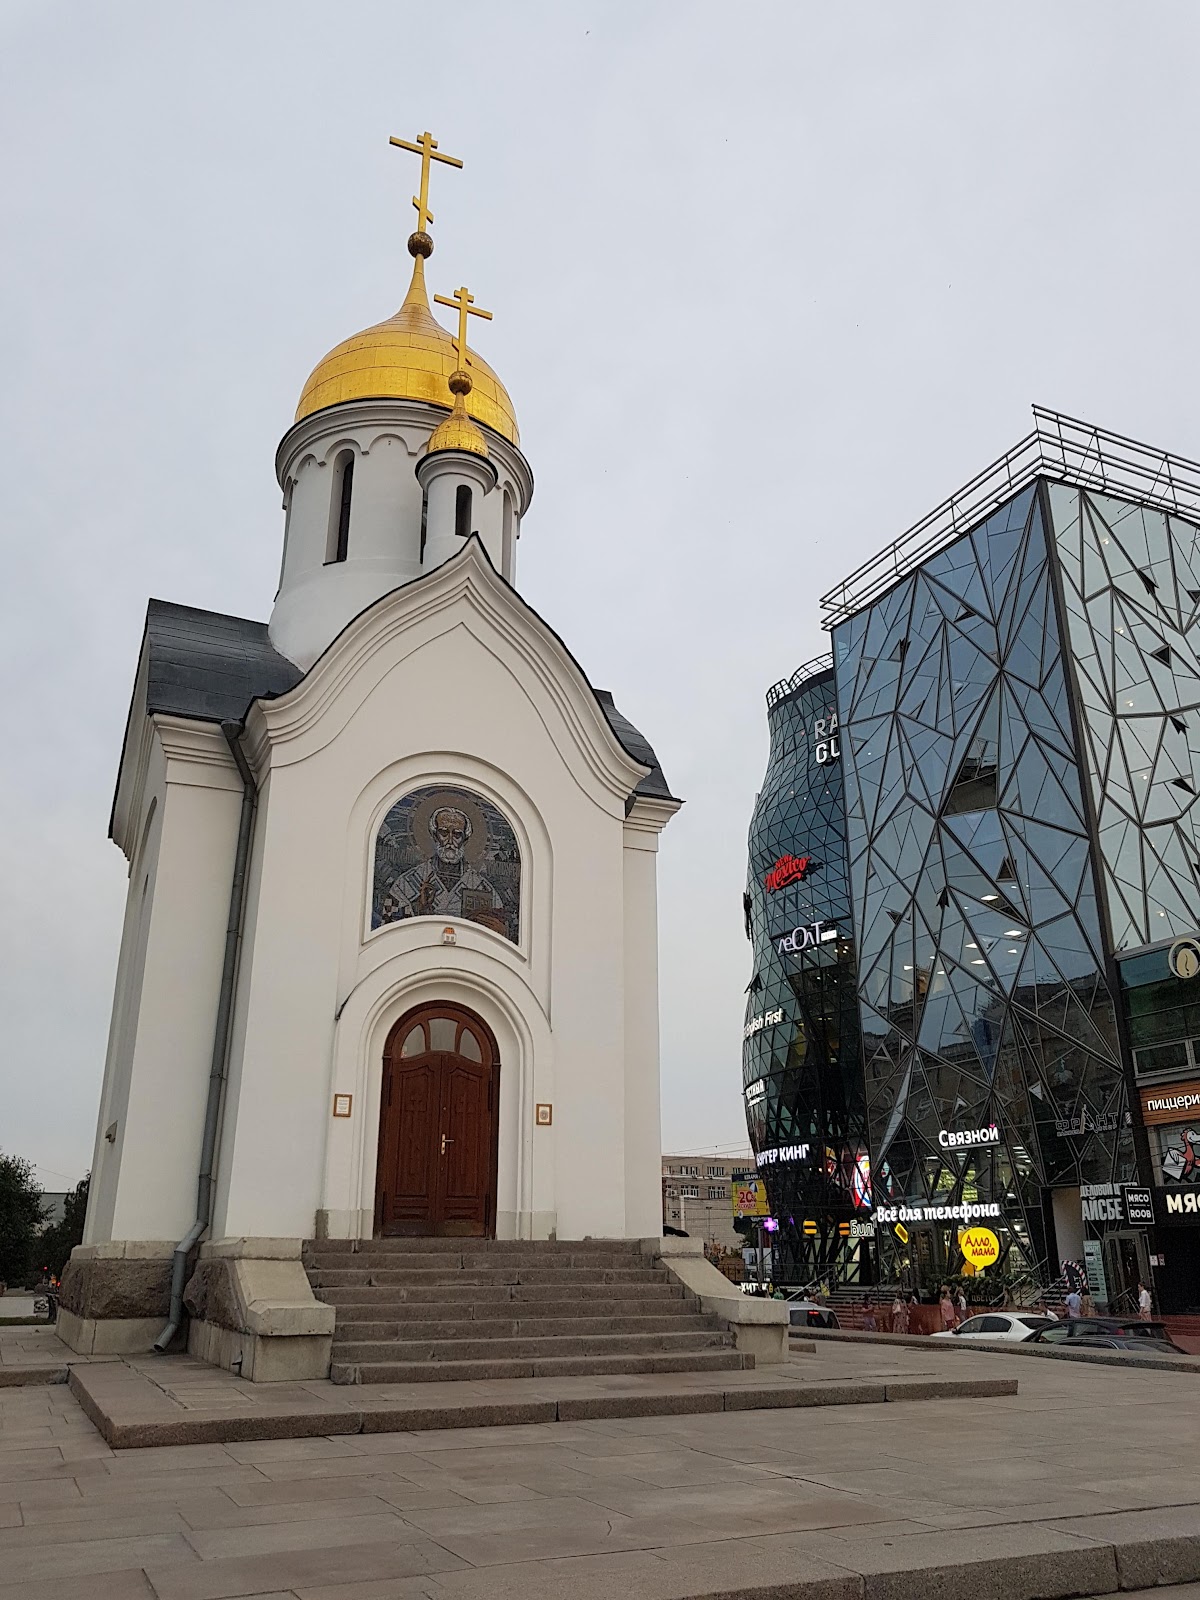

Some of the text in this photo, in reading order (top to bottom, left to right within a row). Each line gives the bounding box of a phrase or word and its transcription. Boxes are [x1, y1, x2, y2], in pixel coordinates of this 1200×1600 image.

[764, 856, 812, 894] Mexico
[764, 1007, 784, 1027] First
[1147, 1093, 1200, 1111] пиццери
[938, 1123, 999, 1147] Связной
[756, 1143, 810, 1167] БУРГЕР КИНГ
[1080, 1182, 1114, 1198] ДЕЛОВОЙ
[1127, 1194, 1150, 1203] МЯСО
[877, 1200, 1000, 1224] Всё для телефона
[1130, 1209, 1152, 1219] ROOB
[964, 1234, 993, 1248] Алло,
[971, 1247, 996, 1257] мама
